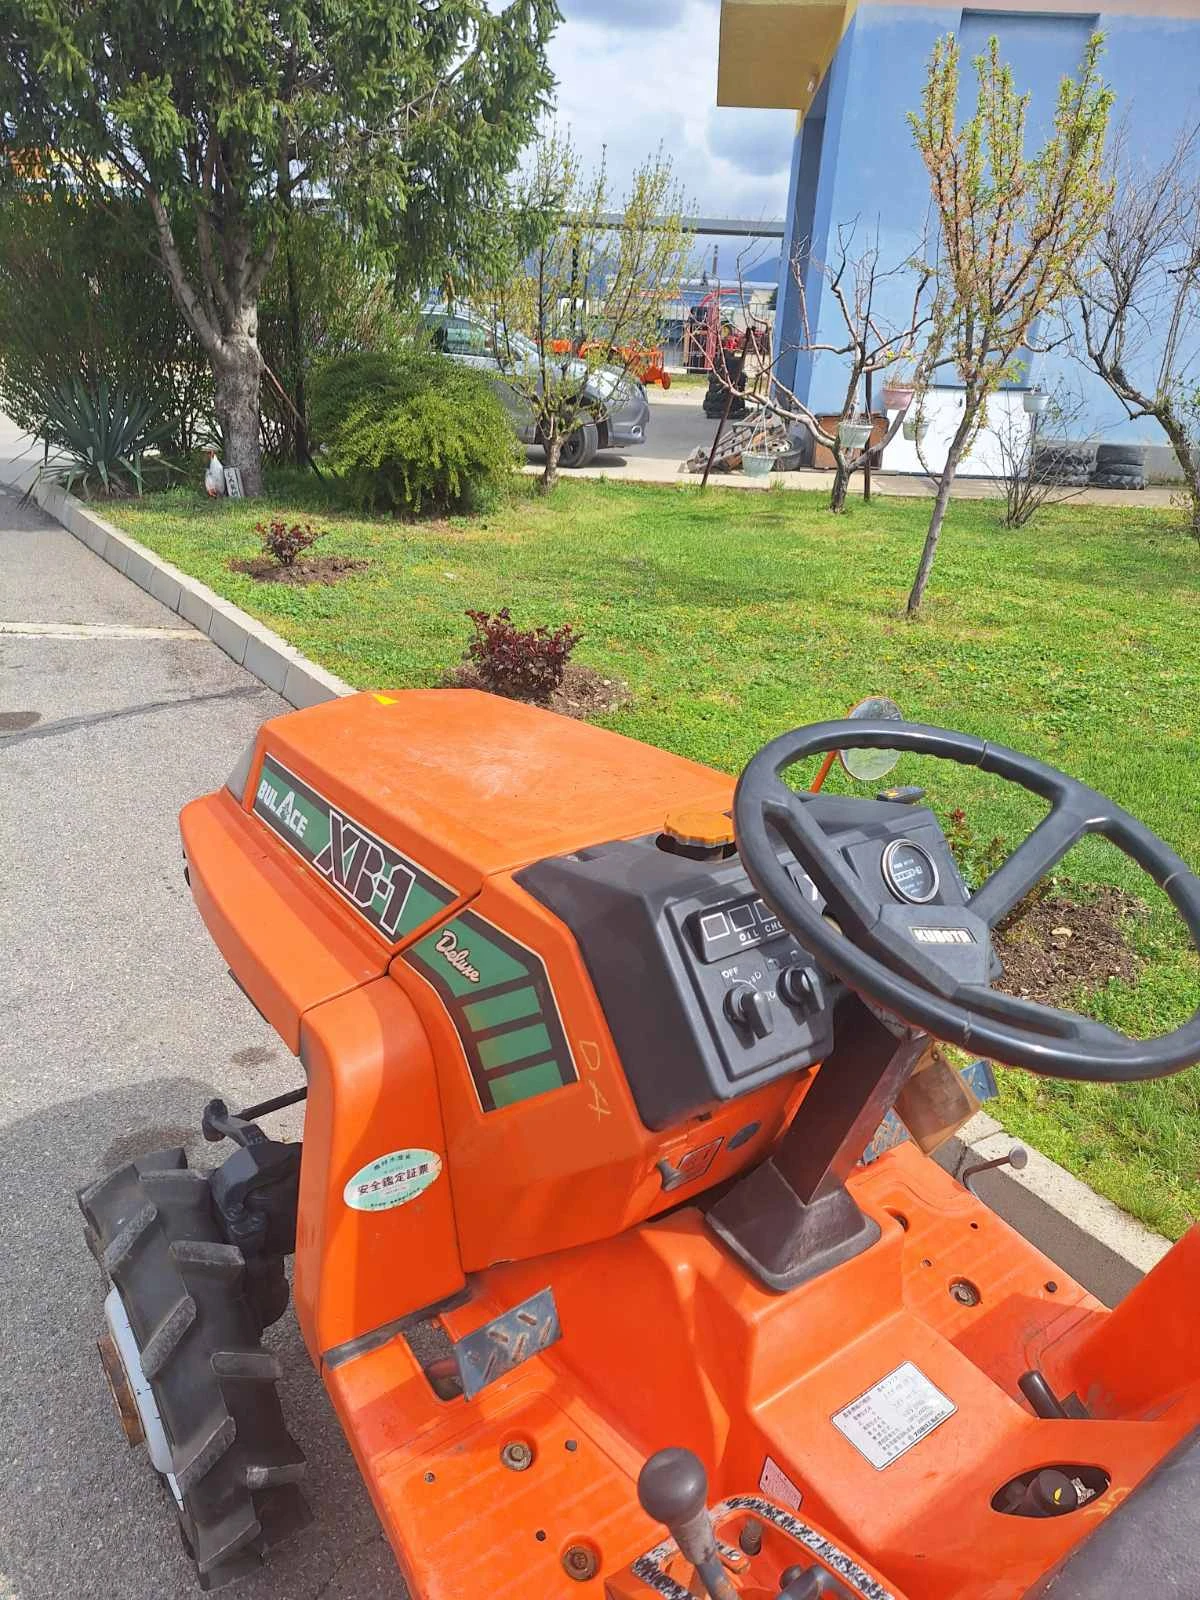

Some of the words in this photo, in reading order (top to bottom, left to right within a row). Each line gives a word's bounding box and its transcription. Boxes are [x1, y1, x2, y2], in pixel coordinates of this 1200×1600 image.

[738, 930, 759, 942] OIL
[435, 929, 481, 983] Deluxe
[720, 966, 739, 979] OFF
